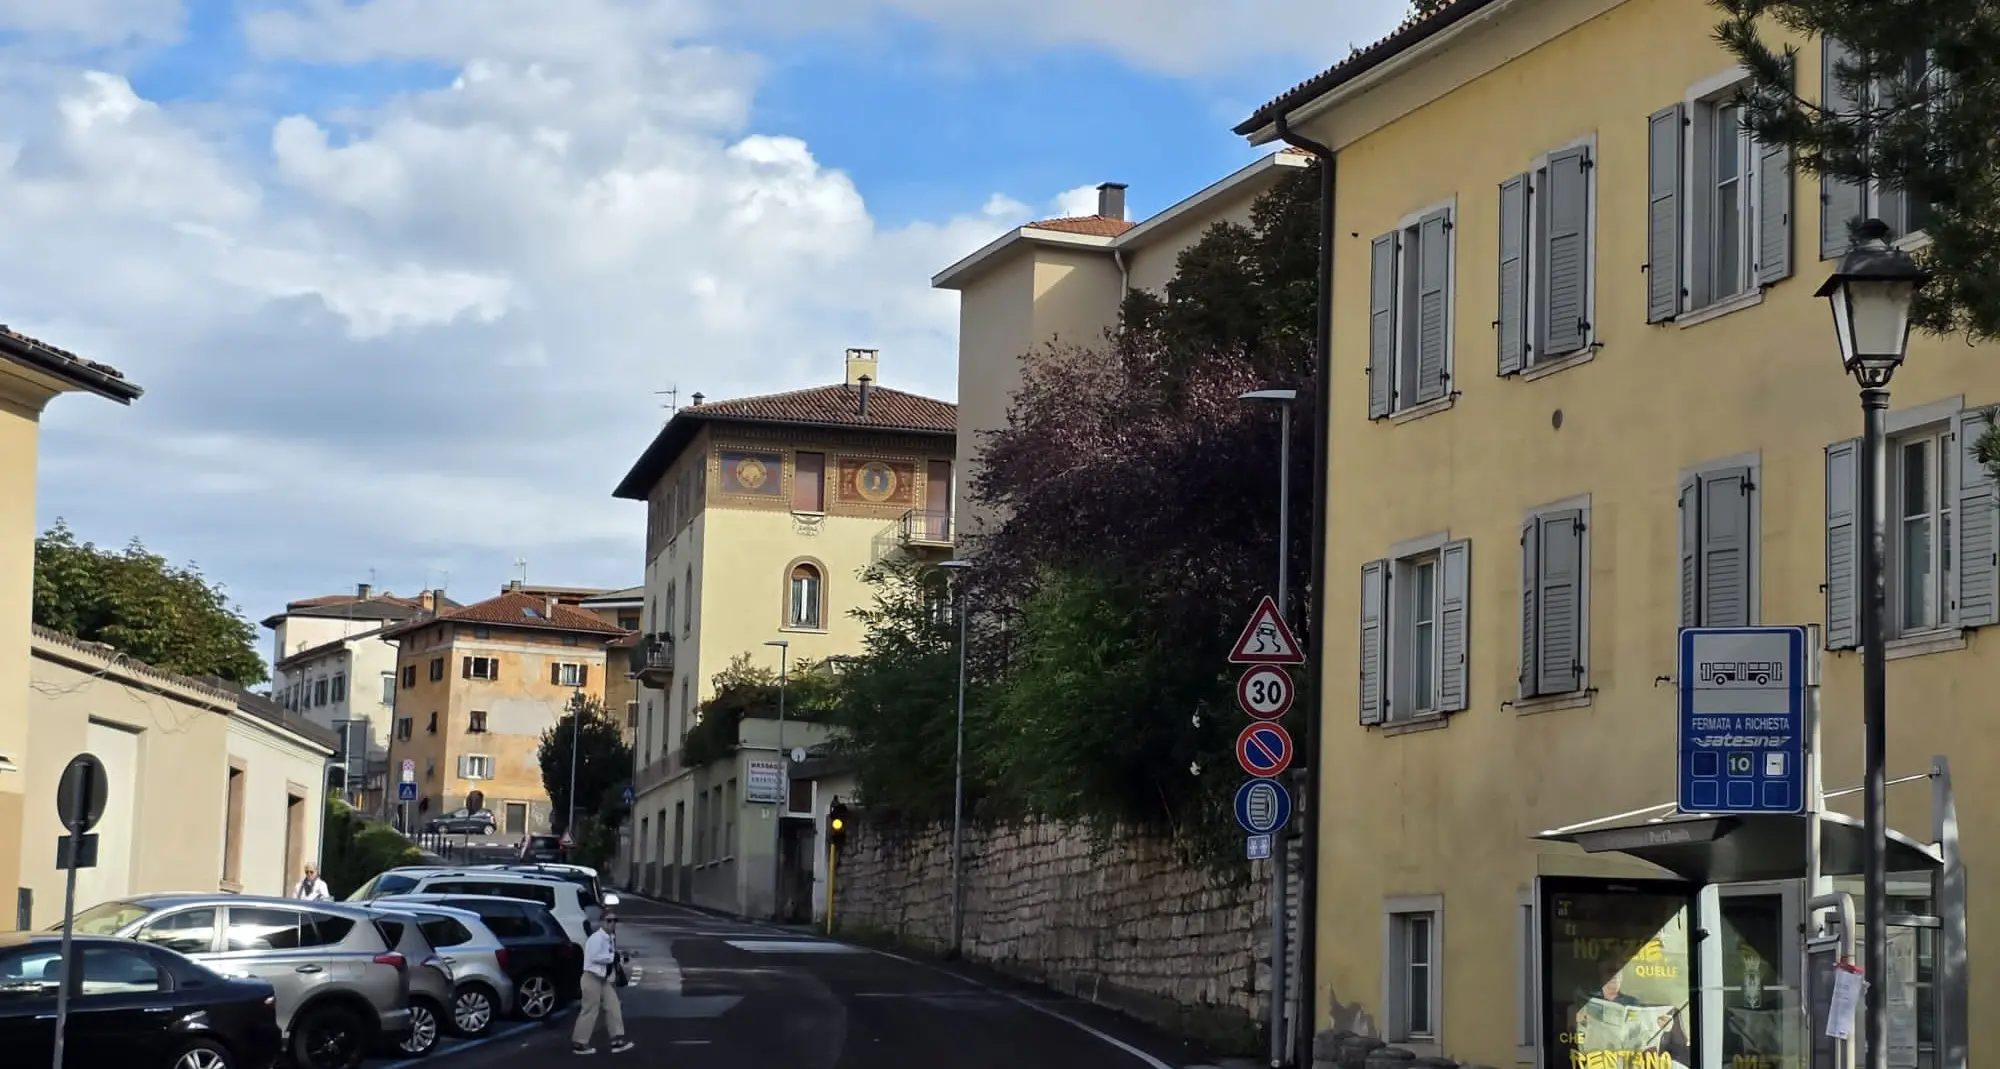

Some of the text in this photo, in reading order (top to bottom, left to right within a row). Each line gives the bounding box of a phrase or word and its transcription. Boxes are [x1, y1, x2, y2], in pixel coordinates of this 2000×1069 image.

[1252, 680, 1281, 704] 30
[1692, 717, 1790, 730] FERMATA A RICHIESTA
[1729, 757, 1749, 772] 10
[1635, 965, 1679, 978] QUELLE
[1559, 1032, 1585, 1045] CHE
